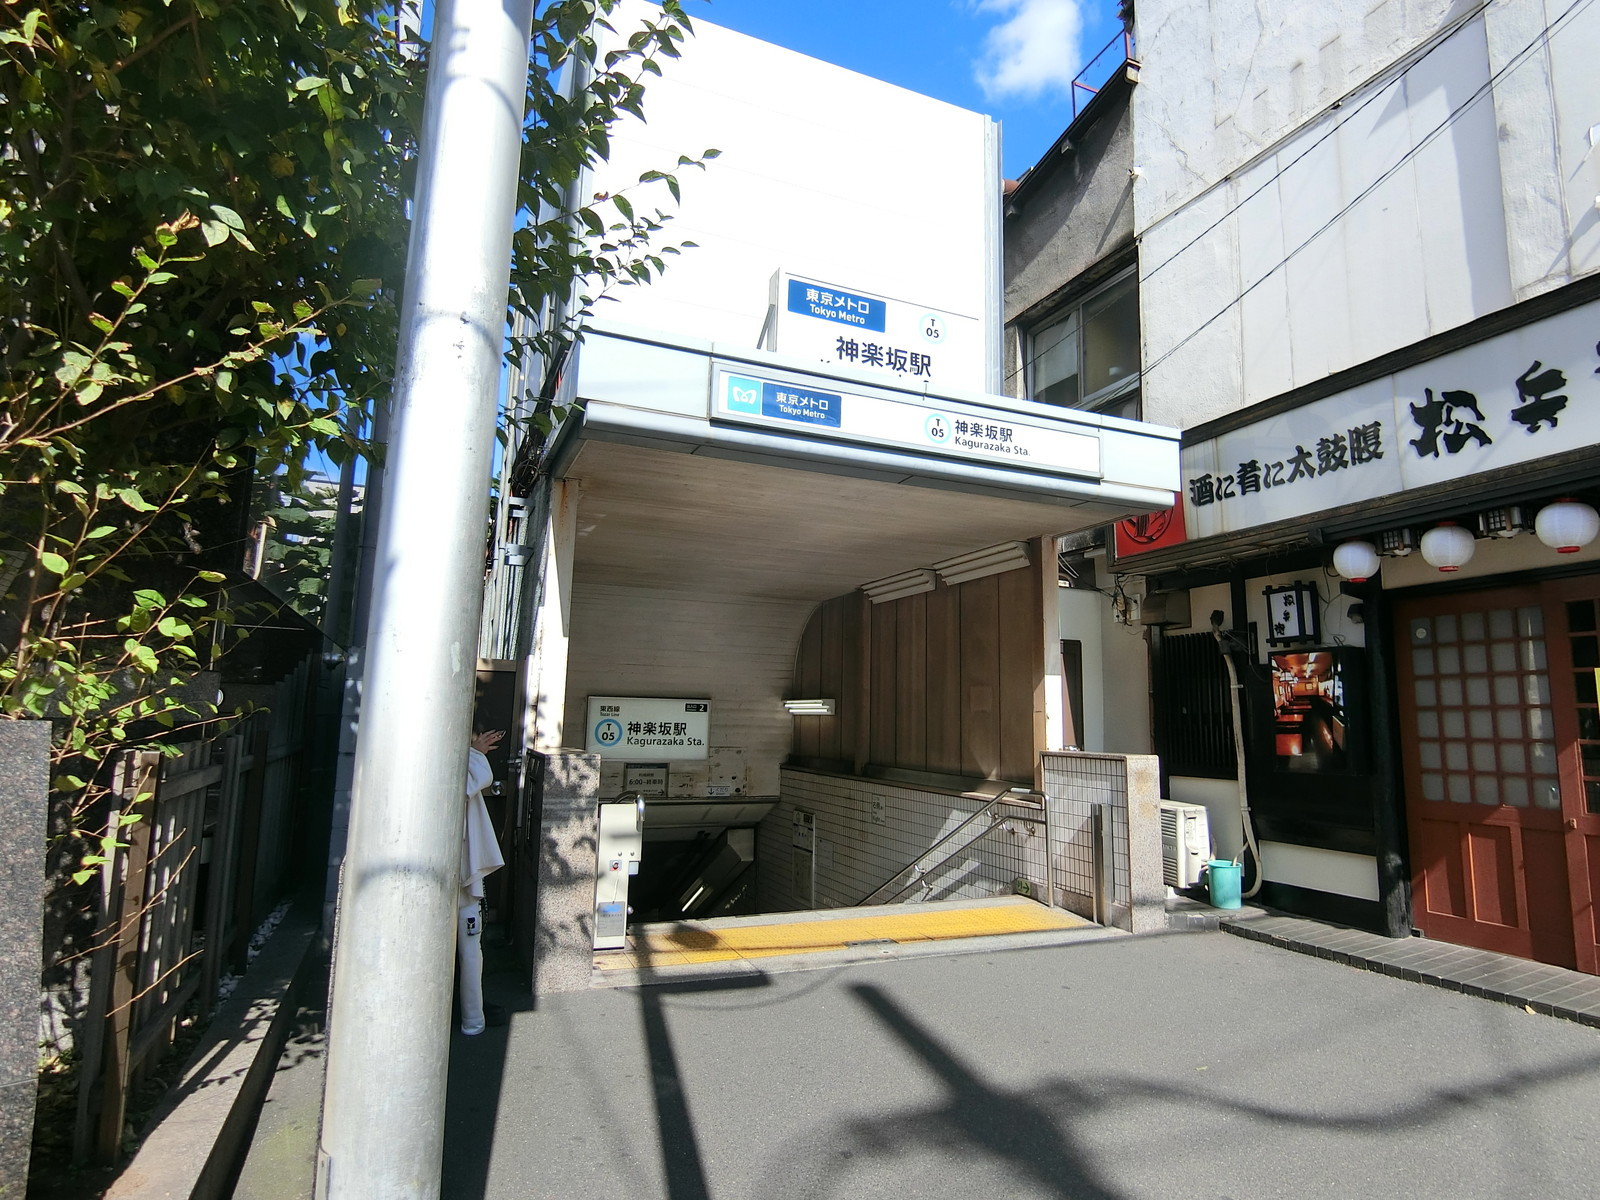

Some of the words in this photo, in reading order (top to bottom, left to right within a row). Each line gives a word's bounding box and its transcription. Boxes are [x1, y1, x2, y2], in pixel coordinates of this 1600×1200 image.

[806, 288, 870, 315] 東京メトロ
[809, 303, 837, 319] Tokyo
[838, 310, 866, 325] Metro
[930, 318, 936, 327] T
[926, 327, 940, 339] 05
[836, 336, 932, 377] 神楽坂駅
[776, 392, 829, 411] 東京メトロ
[1408, 340, 1600, 459] 松兵
[779, 404, 802, 417] Tokyo
[802, 408, 826, 420] Metro
[935, 418, 941, 427] T
[931, 427, 945, 438] 05
[955, 419, 1013, 442] 神楽坂駅
[955, 436, 1011, 454] Kagurazaka
[1013, 445, 1031, 457] Sta.
[1189, 420, 1385, 507] 酒に肴に太鼓腹
[699, 704, 705, 712] 2
[606, 723, 612, 731] T
[627, 721, 687, 736] 神楽坂駅
[602, 732, 615, 741] 05
[627, 736, 684, 748] Kagurazaka
[686, 737, 705, 746] Sta.
